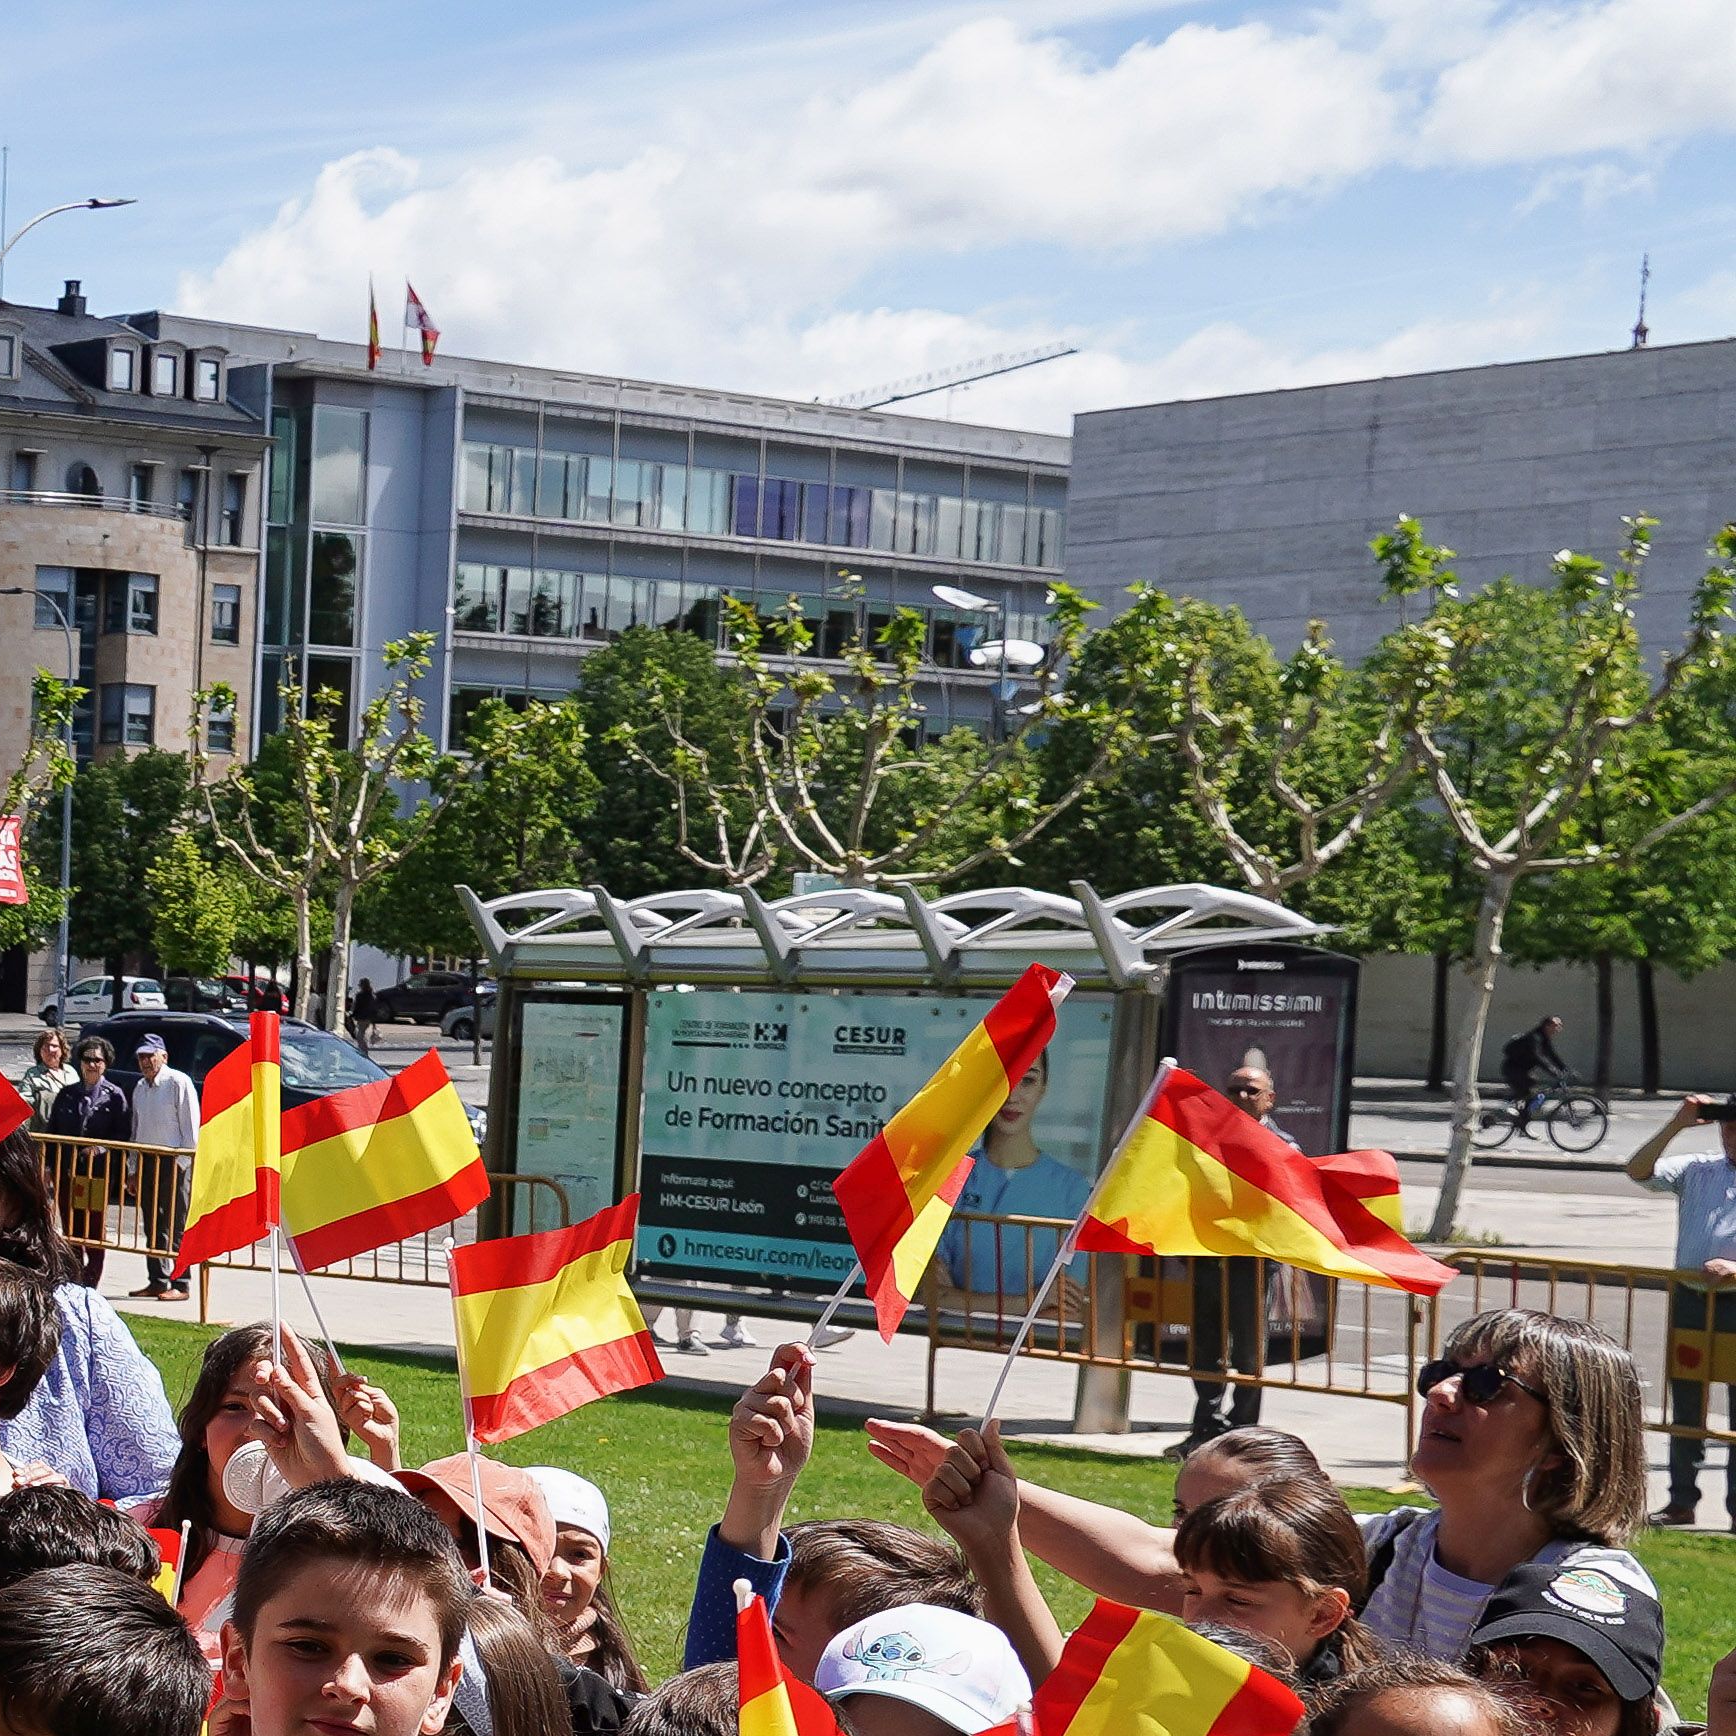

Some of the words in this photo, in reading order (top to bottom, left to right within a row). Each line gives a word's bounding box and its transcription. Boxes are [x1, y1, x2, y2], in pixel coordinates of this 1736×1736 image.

[834, 1025, 907, 1045] CESUR
[666, 1070, 697, 1093] Un
[702, 1076, 772, 1097] nuevo
[777, 1079, 888, 1108] concepto
[664, 1105, 694, 1128] de
[697, 1106, 820, 1136] Formación
